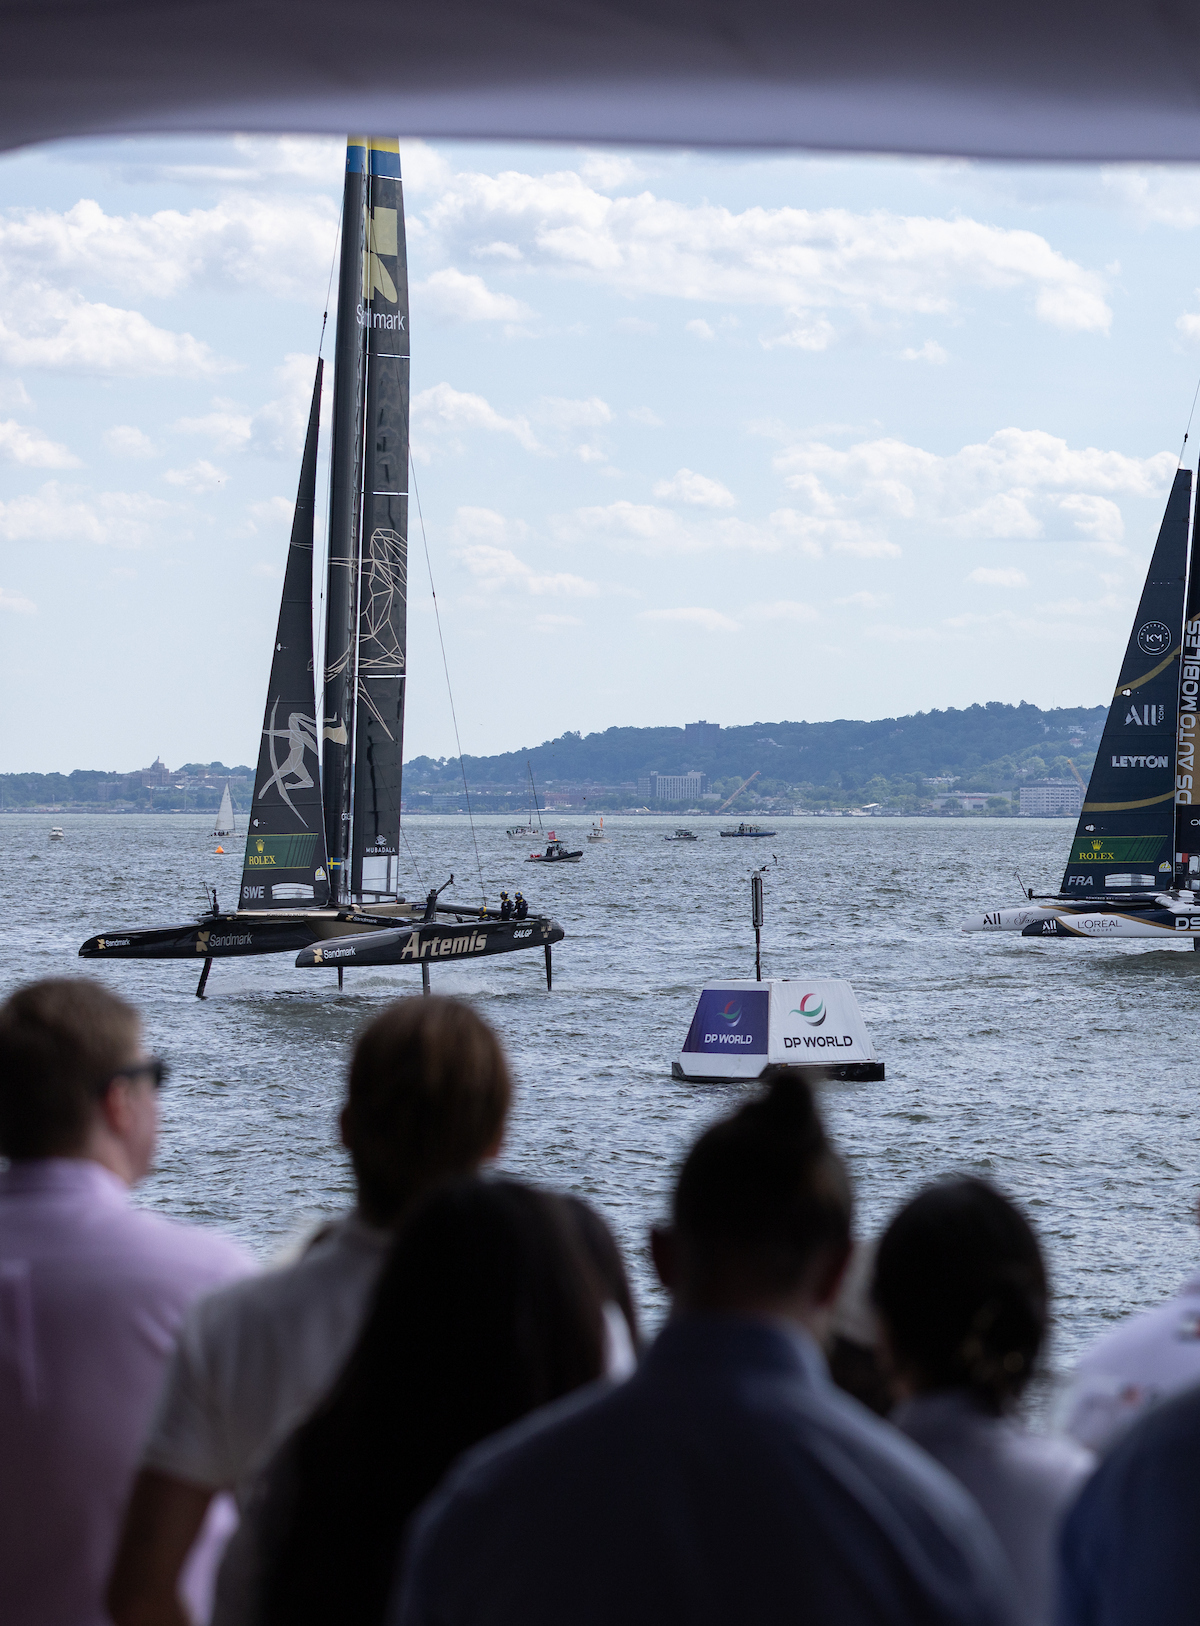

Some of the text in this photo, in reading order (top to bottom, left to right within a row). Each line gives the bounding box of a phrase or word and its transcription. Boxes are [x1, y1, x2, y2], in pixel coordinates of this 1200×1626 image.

[356, 303, 406, 331] Sdmark
[1112, 755, 1168, 768] LEYTON
[1175, 774, 1193, 805] DS
[248, 855, 276, 865] ROLEX
[1078, 852, 1114, 860] ROLEX
[1068, 876, 1094, 886] FRA
[243, 886, 266, 899] SWE
[105, 938, 130, 948] Sandmark
[209, 932, 253, 947] Sandmark
[400, 930, 488, 960] Artemis
[324, 946, 356, 960] Sandmark
[704, 1034, 753, 1045] DP WORLD
[784, 1035, 853, 1048] DP WORLD
